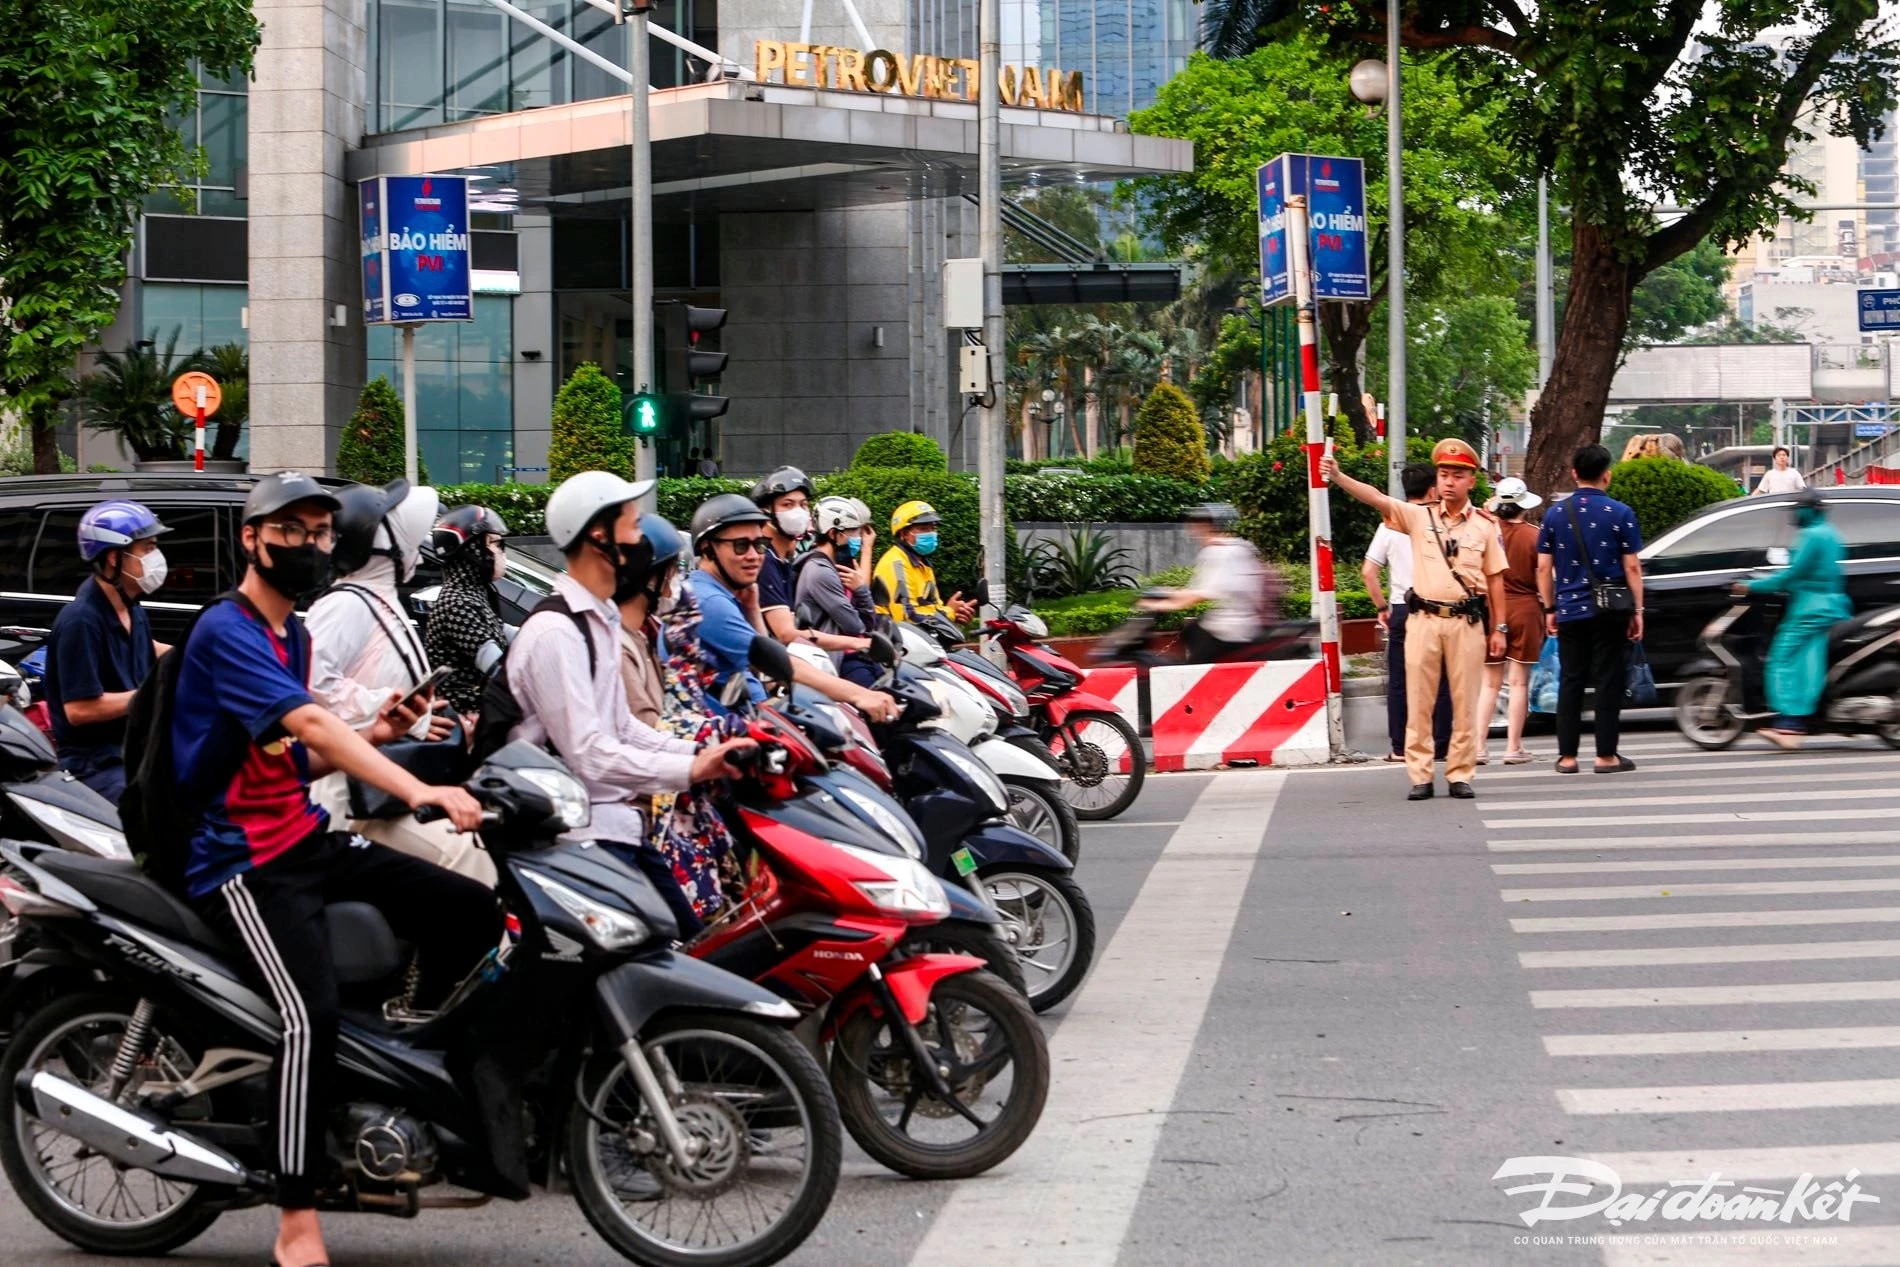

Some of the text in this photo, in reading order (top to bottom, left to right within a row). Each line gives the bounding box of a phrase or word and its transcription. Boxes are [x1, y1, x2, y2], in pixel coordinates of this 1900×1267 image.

[1329, 206, 1363, 232] HIỂM
[389, 226, 426, 250] BẢO
[429, 224, 467, 250] HIỂM
[1318, 234, 1342, 250] PVI
[417, 255, 443, 272] PVI
[813, 950, 864, 961] HONDA
